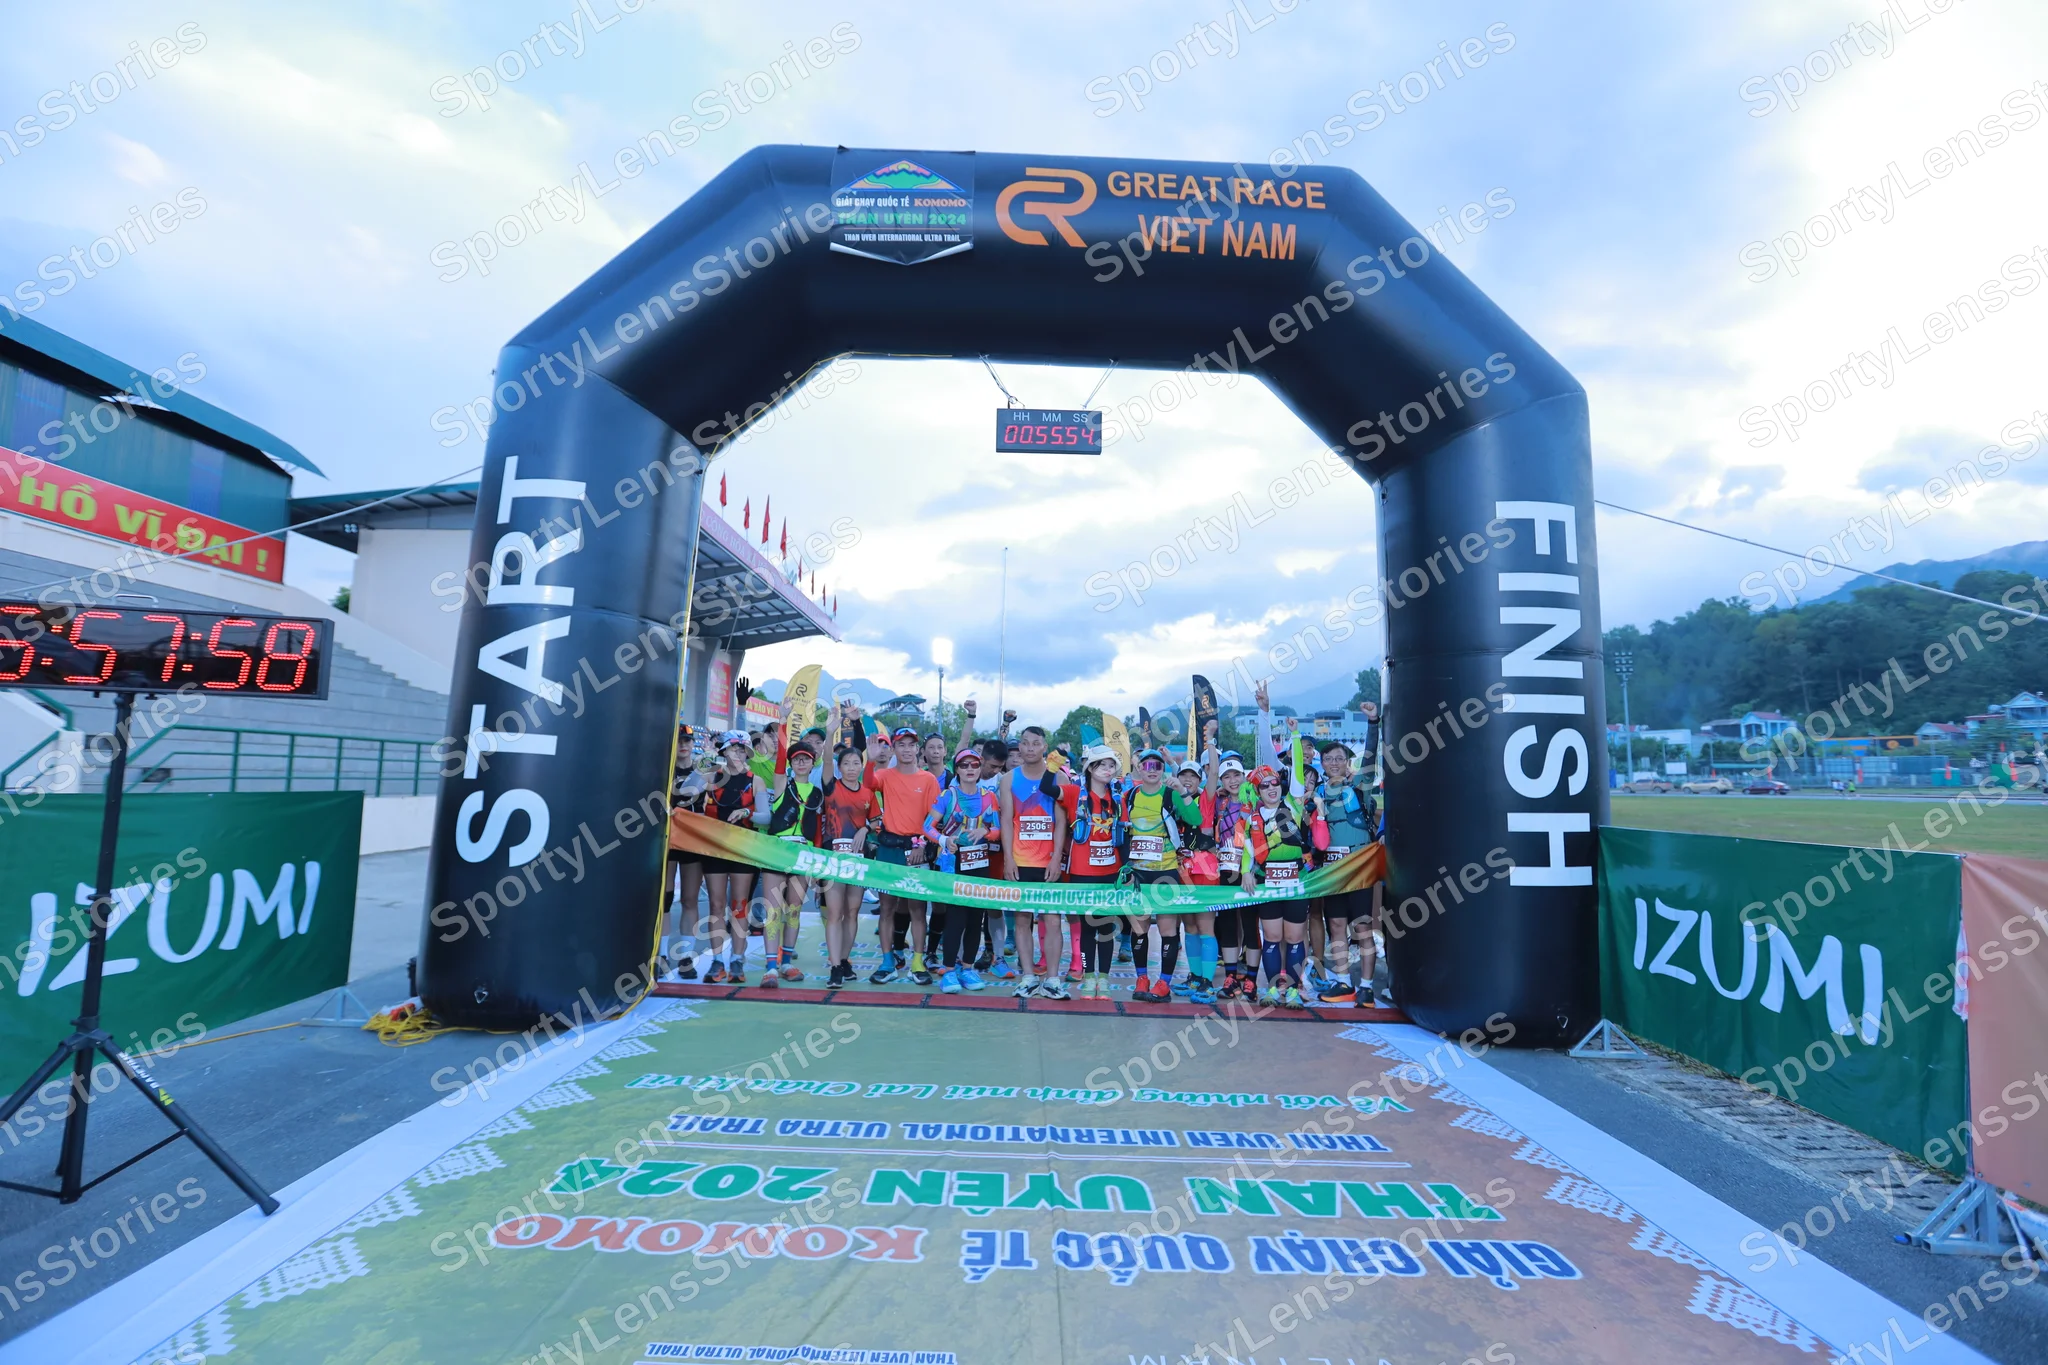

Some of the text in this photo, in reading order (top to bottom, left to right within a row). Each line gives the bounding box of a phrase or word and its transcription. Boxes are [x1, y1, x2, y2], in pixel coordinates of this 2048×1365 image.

[1106, 171, 1327, 210] GREAT RACE
[913, 198, 967, 208] KOMOMO
[838, 212, 879, 225] THAN
[928, 213, 967, 225] 2024
[844, 233, 860, 242] THAN
[877, 234, 923, 242] INTERNATIONAL
[924, 234, 943, 242] ULTRA
[944, 234, 961, 242] TRAIL
[1137, 213, 1298, 261] VIET NAM
[1013, 411, 1088, 423] HH MM SS
[18, 476, 269, 572] HỒ VĨ ĐẠI !
[455, 455, 587, 867] START
[1495, 500, 1593, 887] FINISH
[1026, 822, 1047, 831] 2506
[1137, 842, 1156, 850] 2556
[967, 851, 984, 860] 2575
[1272, 869, 1292, 877] 2567
[953, 881, 1021, 902] KOMOMO
[1025, 889, 1062, 905] THAN
[1106, 890, 1142, 907] 2024
[17, 860, 321, 997] IZUMI
[1633, 897, 1883, 1046] IZUMI
[863, 1083, 938, 1099] Lai
[667, 1115, 1392, 1152] THAN UYEN INTERNATIONAL ULTRA TRAIL
[547, 1158, 1506, 1221] THAN UYÊN 2024
[488, 1214, 1585, 1290] GIẢI CHẠY QUỐC TẾ KOMOMO
[647, 1343, 690, 1356] TRAIL
[695, 1347, 743, 1359] ULTRA
[748, 1346, 865, 1363] INTERNATIONAL
[869, 1351, 909, 1364] UYEN
[912, 1352, 958, 1365] THAN
